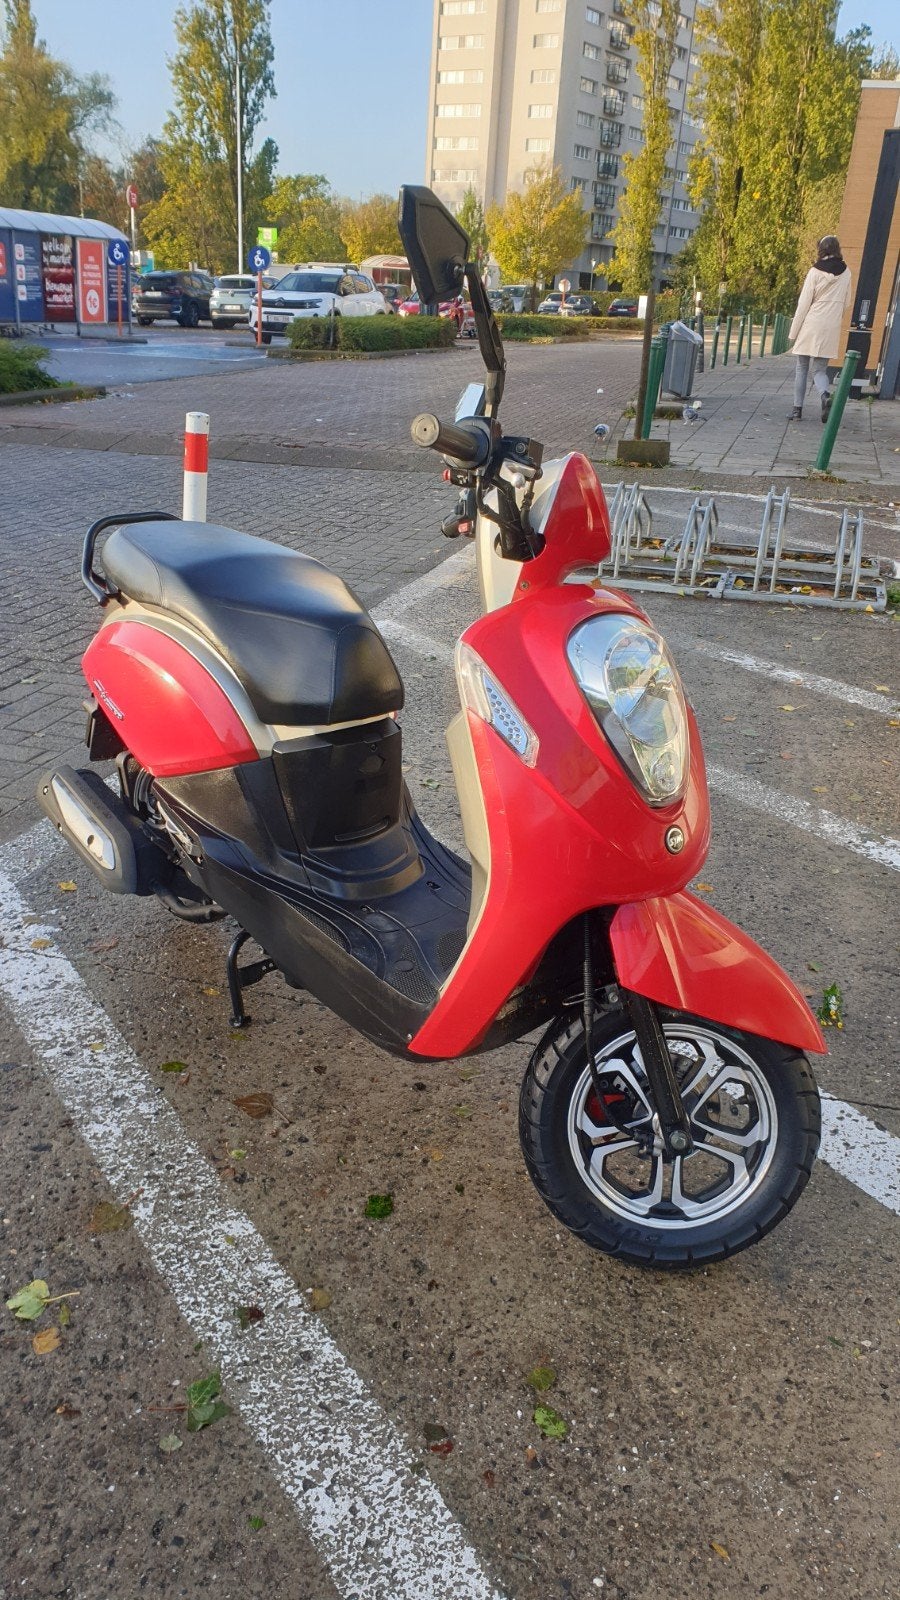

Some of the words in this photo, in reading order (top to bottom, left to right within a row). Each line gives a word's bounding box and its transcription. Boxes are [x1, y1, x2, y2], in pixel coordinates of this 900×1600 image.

[42, 237, 72, 254] welkom
[88, 296, 98, 308] 1€
[669, 835, 683, 848] SYM
